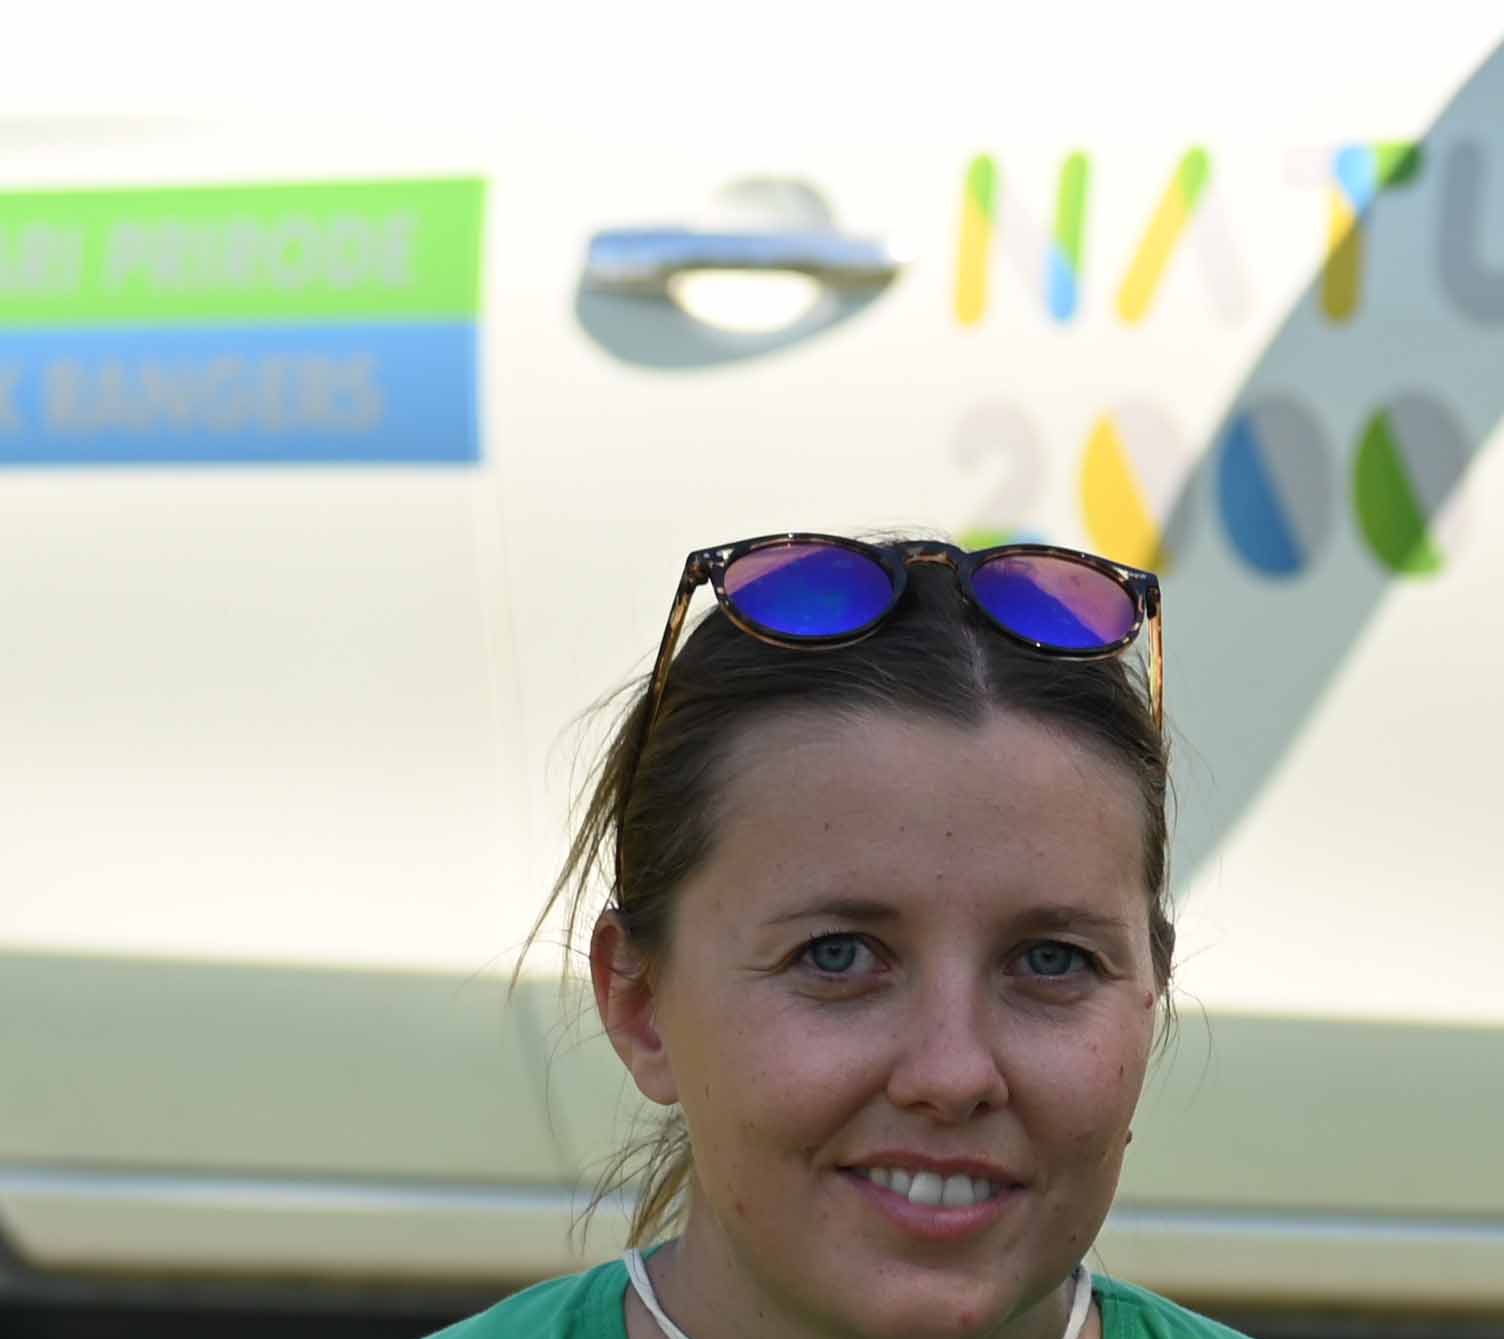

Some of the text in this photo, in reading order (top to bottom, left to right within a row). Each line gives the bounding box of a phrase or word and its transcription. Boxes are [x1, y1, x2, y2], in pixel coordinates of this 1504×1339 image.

[104, 209, 421, 295] PRIRODE
[40, 348, 388, 438] RANGERS
[949, 386, 1474, 581] 2000
